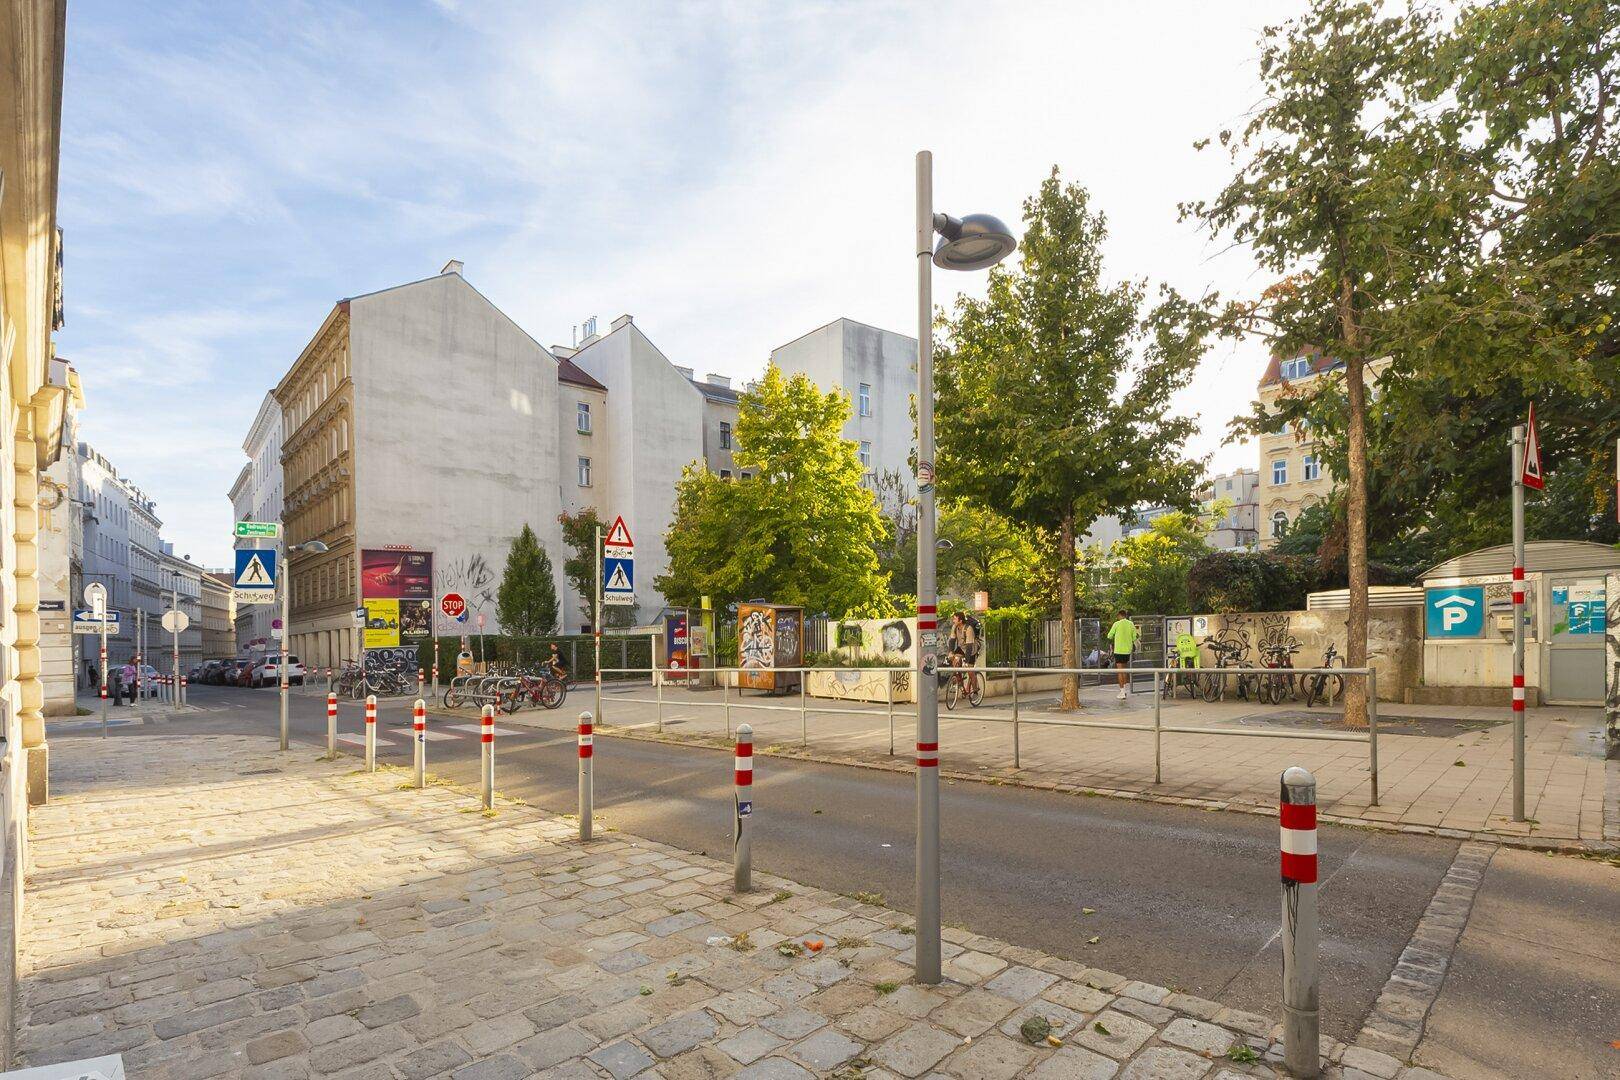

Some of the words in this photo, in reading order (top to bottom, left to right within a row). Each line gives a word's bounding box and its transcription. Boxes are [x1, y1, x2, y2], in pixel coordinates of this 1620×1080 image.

[605, 594, 633, 602] Schulweg
[443, 600, 463, 610] STOP
[1443, 606, 1468, 631] P
